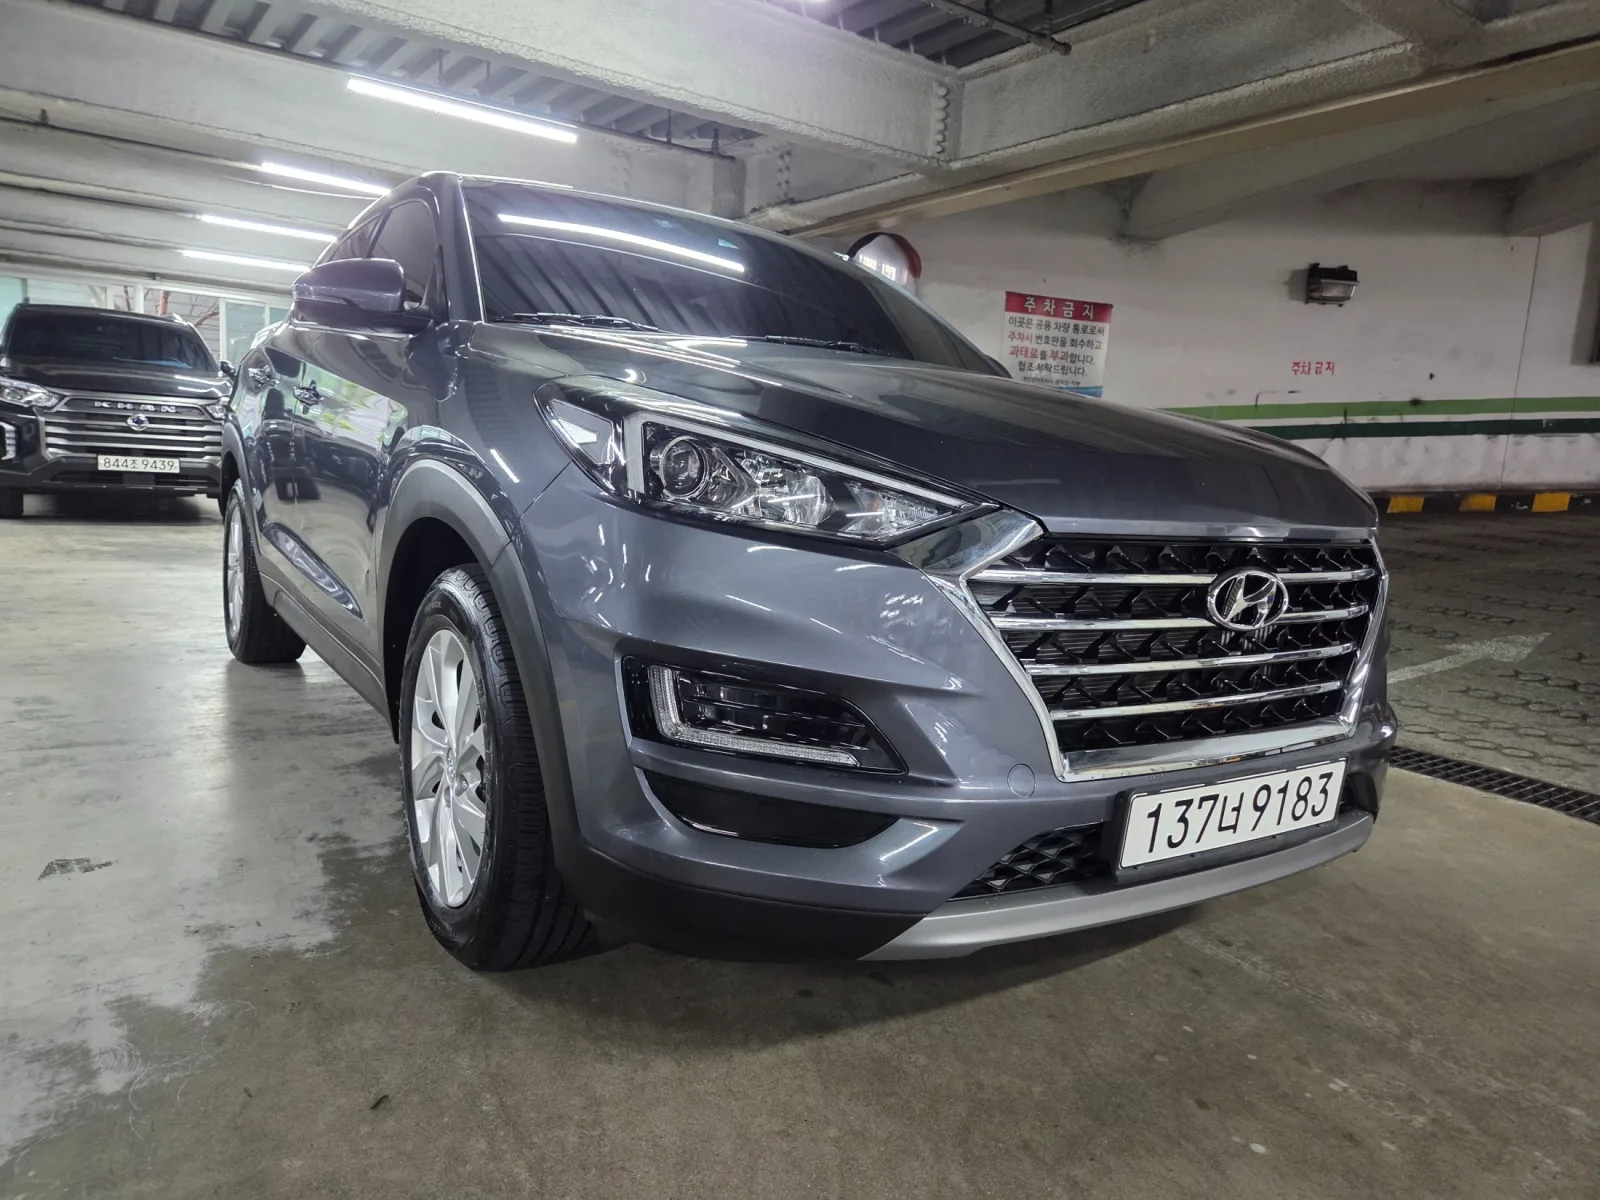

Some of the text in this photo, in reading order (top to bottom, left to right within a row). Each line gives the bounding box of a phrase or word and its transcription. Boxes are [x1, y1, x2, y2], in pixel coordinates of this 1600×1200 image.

[1008, 316, 1105, 336] 이곳은 공용 차량 통로로써
[1008, 331, 1102, 350] 주차시 번호판을 회수하고
[1009, 346, 1047, 360] 과태료를
[1018, 361, 1034, 372] 협조
[94, 402, 176, 413] KHAN
